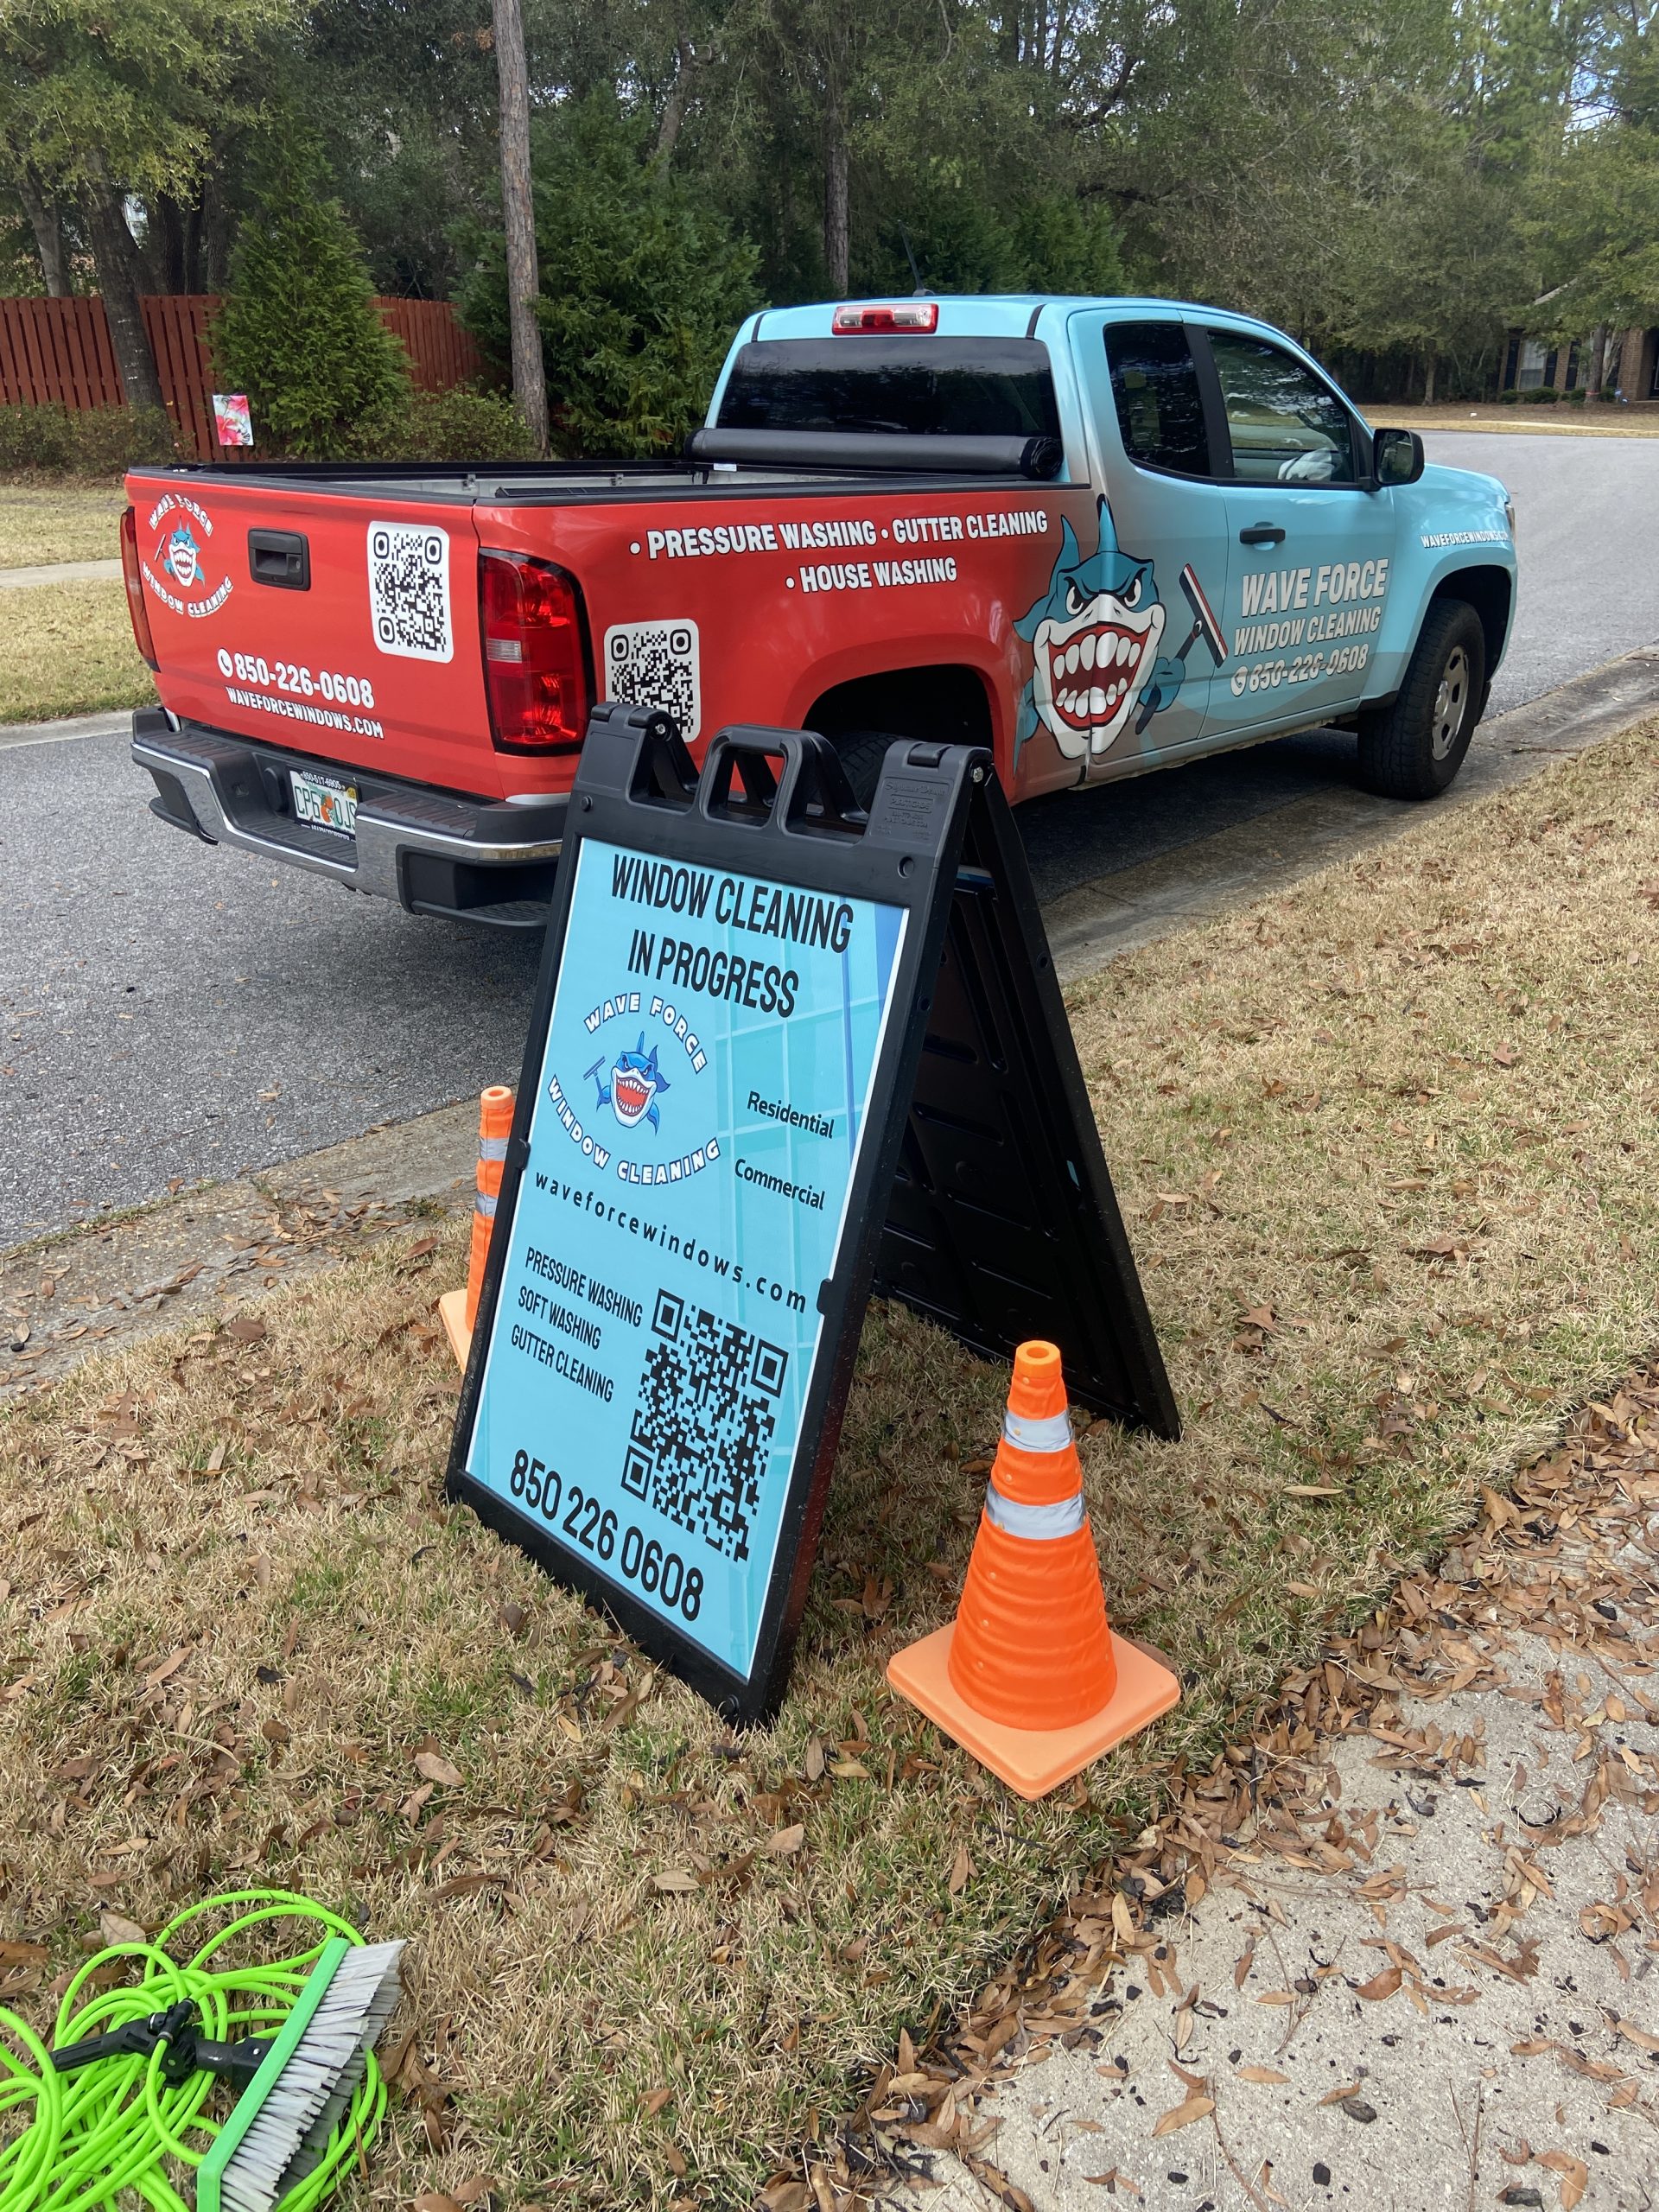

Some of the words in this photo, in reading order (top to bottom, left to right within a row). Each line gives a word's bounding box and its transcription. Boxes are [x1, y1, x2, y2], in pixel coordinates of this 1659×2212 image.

[149, 493, 175, 531] WAVE
[175, 493, 213, 537] FORCE
[646, 524, 779, 560] PRESSURE
[779, 519, 878, 551] WASHING
[892, 515, 963, 544] GUTTER
[965, 509, 1048, 539] CLEANING
[143, 560, 184, 615] WINDOW
[188, 574, 233, 619] CLEANING
[798, 562, 872, 594] HOUSE
[873, 556, 958, 588] WASHING
[1241, 567, 1312, 618] WAVE
[1313, 557, 1389, 607] FORCE
[1234, 618, 1306, 657] WINDOW
[1306, 605, 1382, 644] CLEANING
[235, 652, 375, 709] 850-226-0608
[1249, 643, 1369, 693] 850-226-0608
[227, 687, 385, 740] WAVEFORCEWINDOWS.COM
[611, 853, 715, 918] WINDOW
[715, 877, 854, 954] CLEANING
[627, 929, 657, 975] IN
[657, 940, 799, 1018] PROGRESS
[583, 991, 642, 1035] WAVE
[649, 996, 709, 1076] FORCE
[548, 1074, 612, 1171] WINDOW
[617, 1136, 721, 1186] CLEANING
[747, 1090, 835, 1140] Residential
[734, 1158, 825, 1211] Commercial
[535, 1171, 807, 1314] waveforcewindows.com
[525, 1246, 587, 1299] PRESSURE
[587, 1278, 643, 1328] WASHING
[518, 1285, 550, 1324] SOFT
[548, 1300, 601, 1351] WASHING
[510, 1324, 556, 1369] GUTTER
[554, 1351, 614, 1403] CLEANING
[509, 1448, 563, 1521] 850
[563, 1486, 619, 1560] 226
[621, 1525, 705, 1622] 0608
